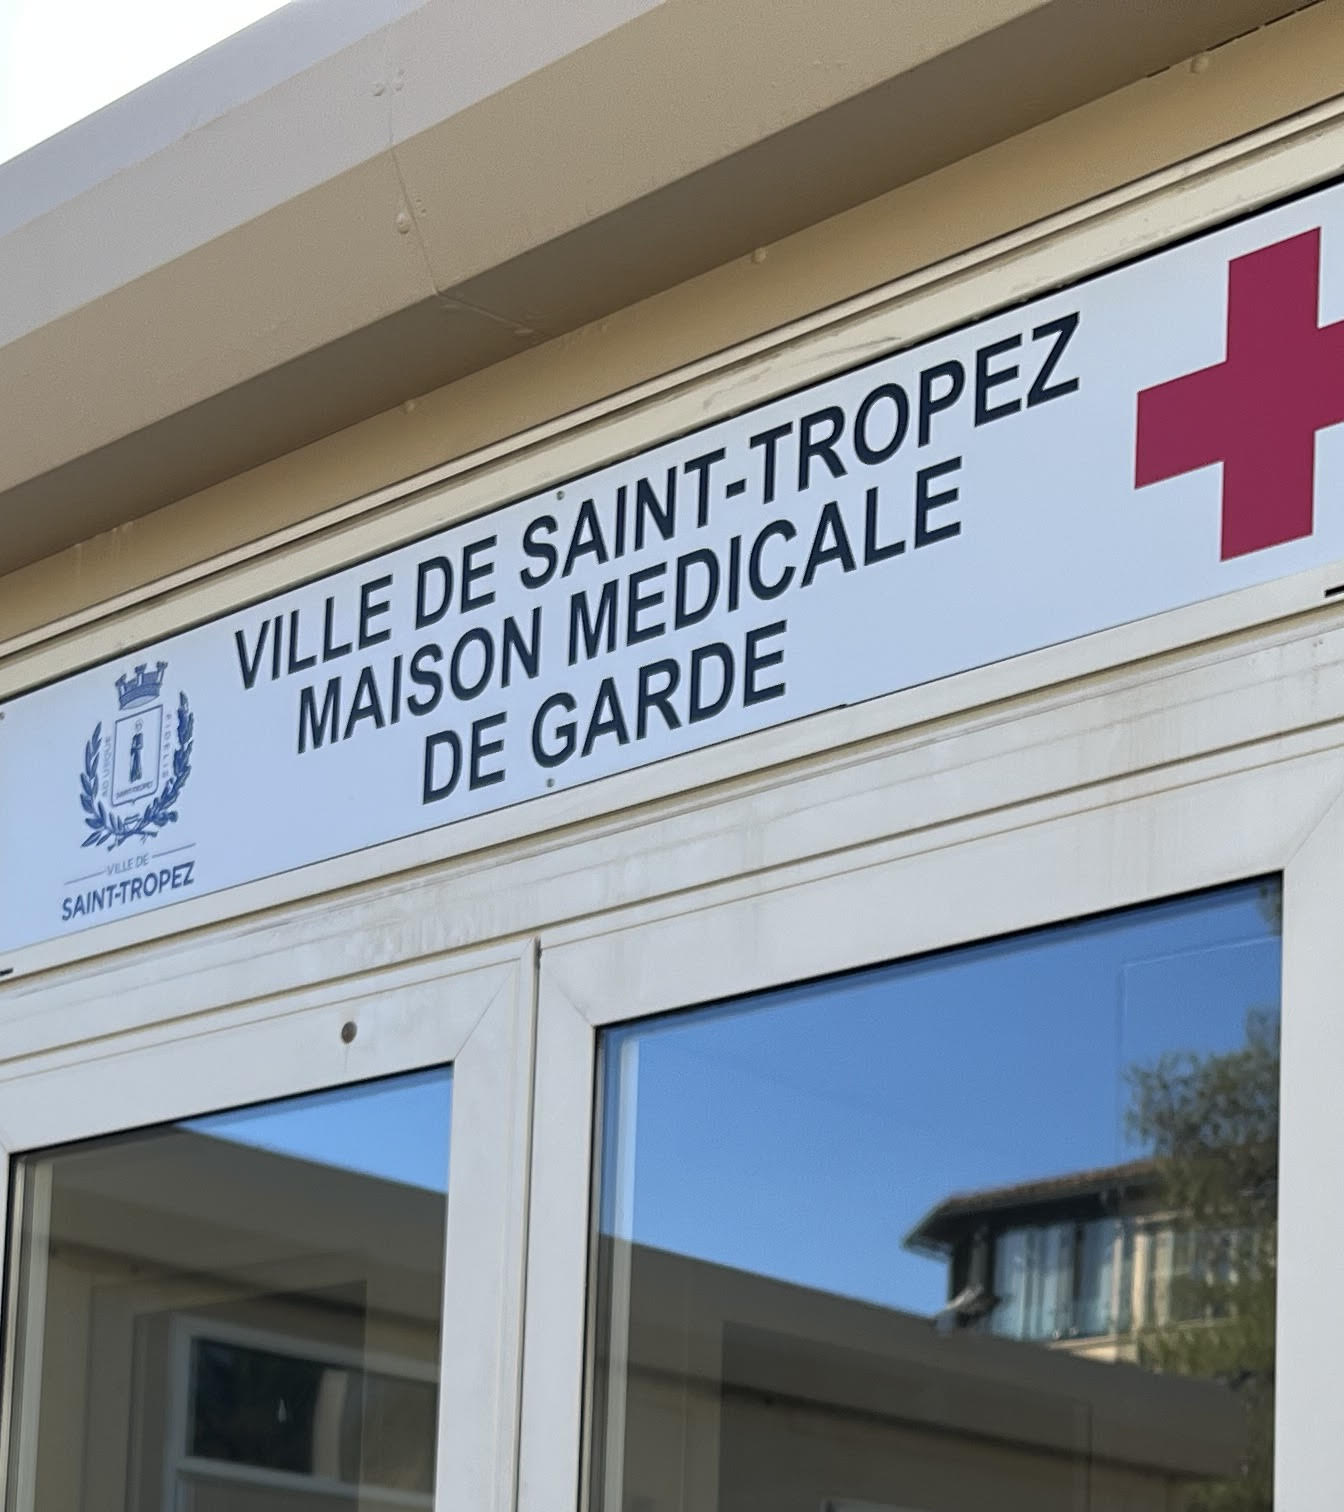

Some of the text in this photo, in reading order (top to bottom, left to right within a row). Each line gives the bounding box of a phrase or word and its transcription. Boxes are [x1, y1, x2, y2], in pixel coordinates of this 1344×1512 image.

[234, 311, 1080, 690] VILLE DE SAINT-TROPEZ
[297, 455, 963, 754] MAISON MEDICALE
[422, 619, 790, 805] DE GARDE
[61, 860, 196, 921] SAINT-TROPEZ
[106, 853, 150, 876] VILLE DE
